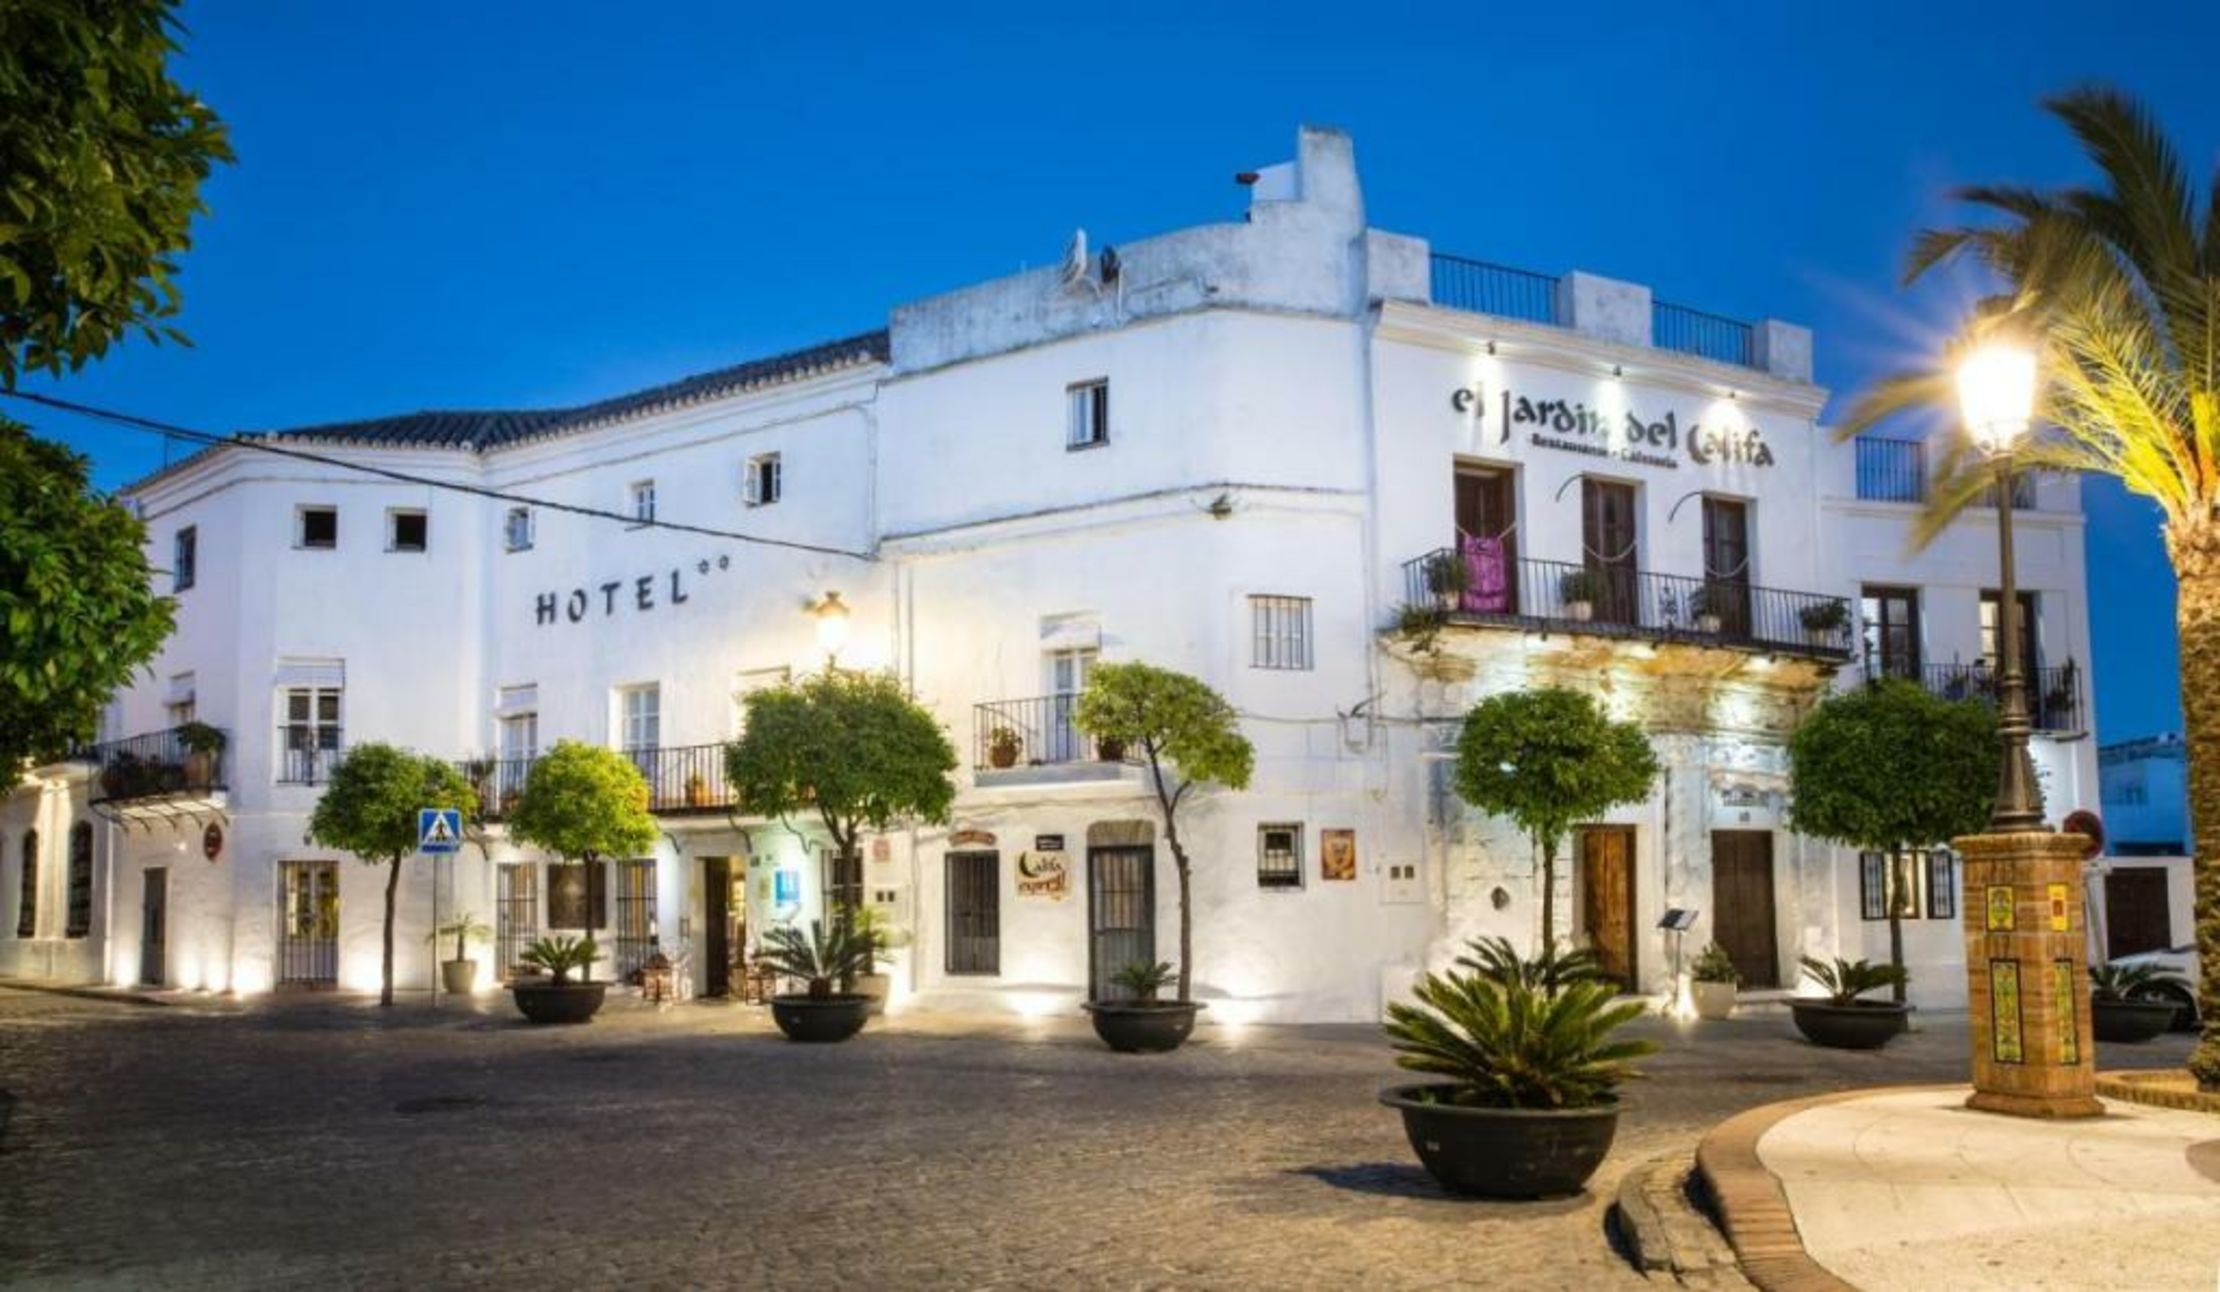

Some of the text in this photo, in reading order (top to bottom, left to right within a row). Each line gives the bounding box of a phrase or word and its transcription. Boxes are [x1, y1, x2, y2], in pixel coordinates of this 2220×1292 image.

[1452, 382, 1485, 418] el
[1626, 405, 1677, 449] del
[1687, 424, 1774, 466] Califa
[535, 568, 688, 626] HOTEL
